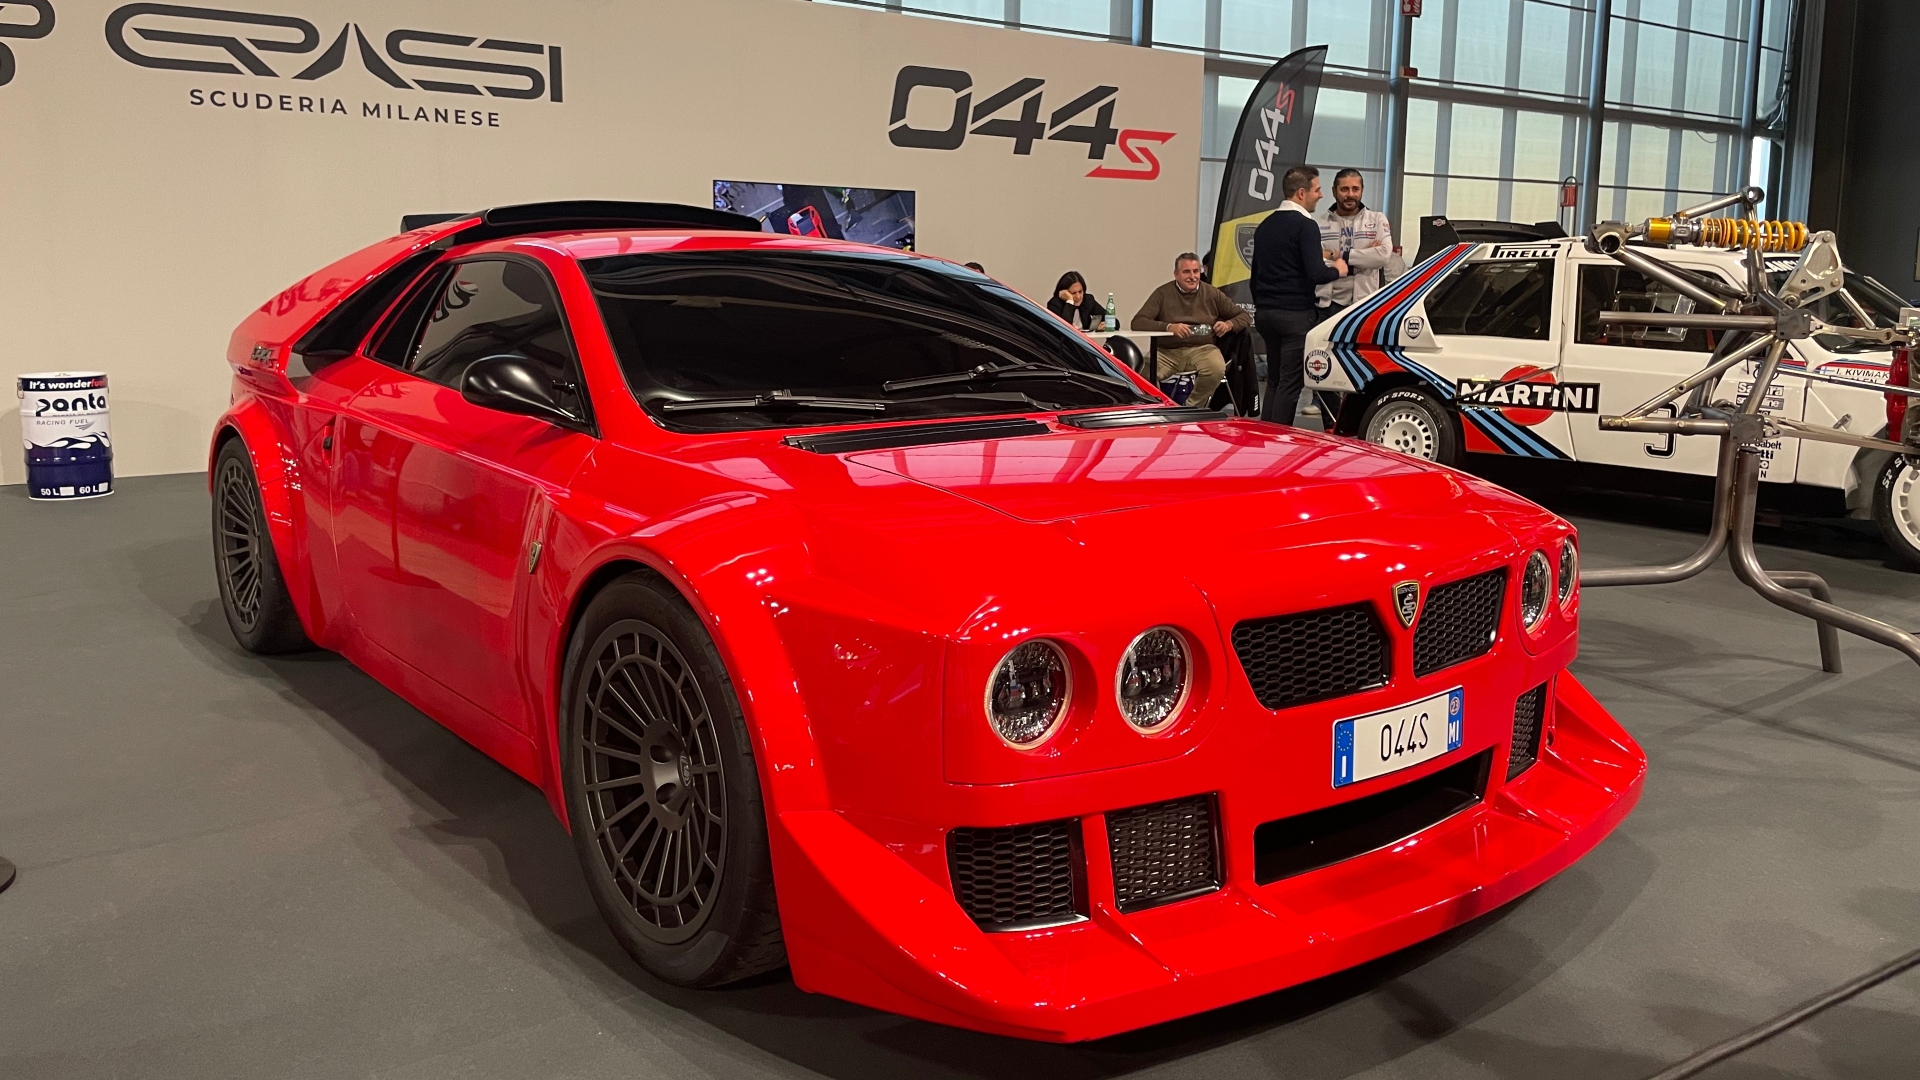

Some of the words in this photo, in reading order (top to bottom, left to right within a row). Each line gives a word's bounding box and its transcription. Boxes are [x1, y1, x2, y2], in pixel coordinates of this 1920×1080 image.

[189, 88, 348, 116] SCUDERIA
[362, 101, 500, 128] MILANESE
[1490, 244, 1561, 258] PIRELLI
[29, 381, 46, 390] It's
[1391, 391, 1425, 402] SPORT
[1461, 383, 1594, 409] MARTINI
[41, 488, 51, 496] 50
[1380, 712, 1429, 761] 044S
[1448, 720, 1460, 745] MI
